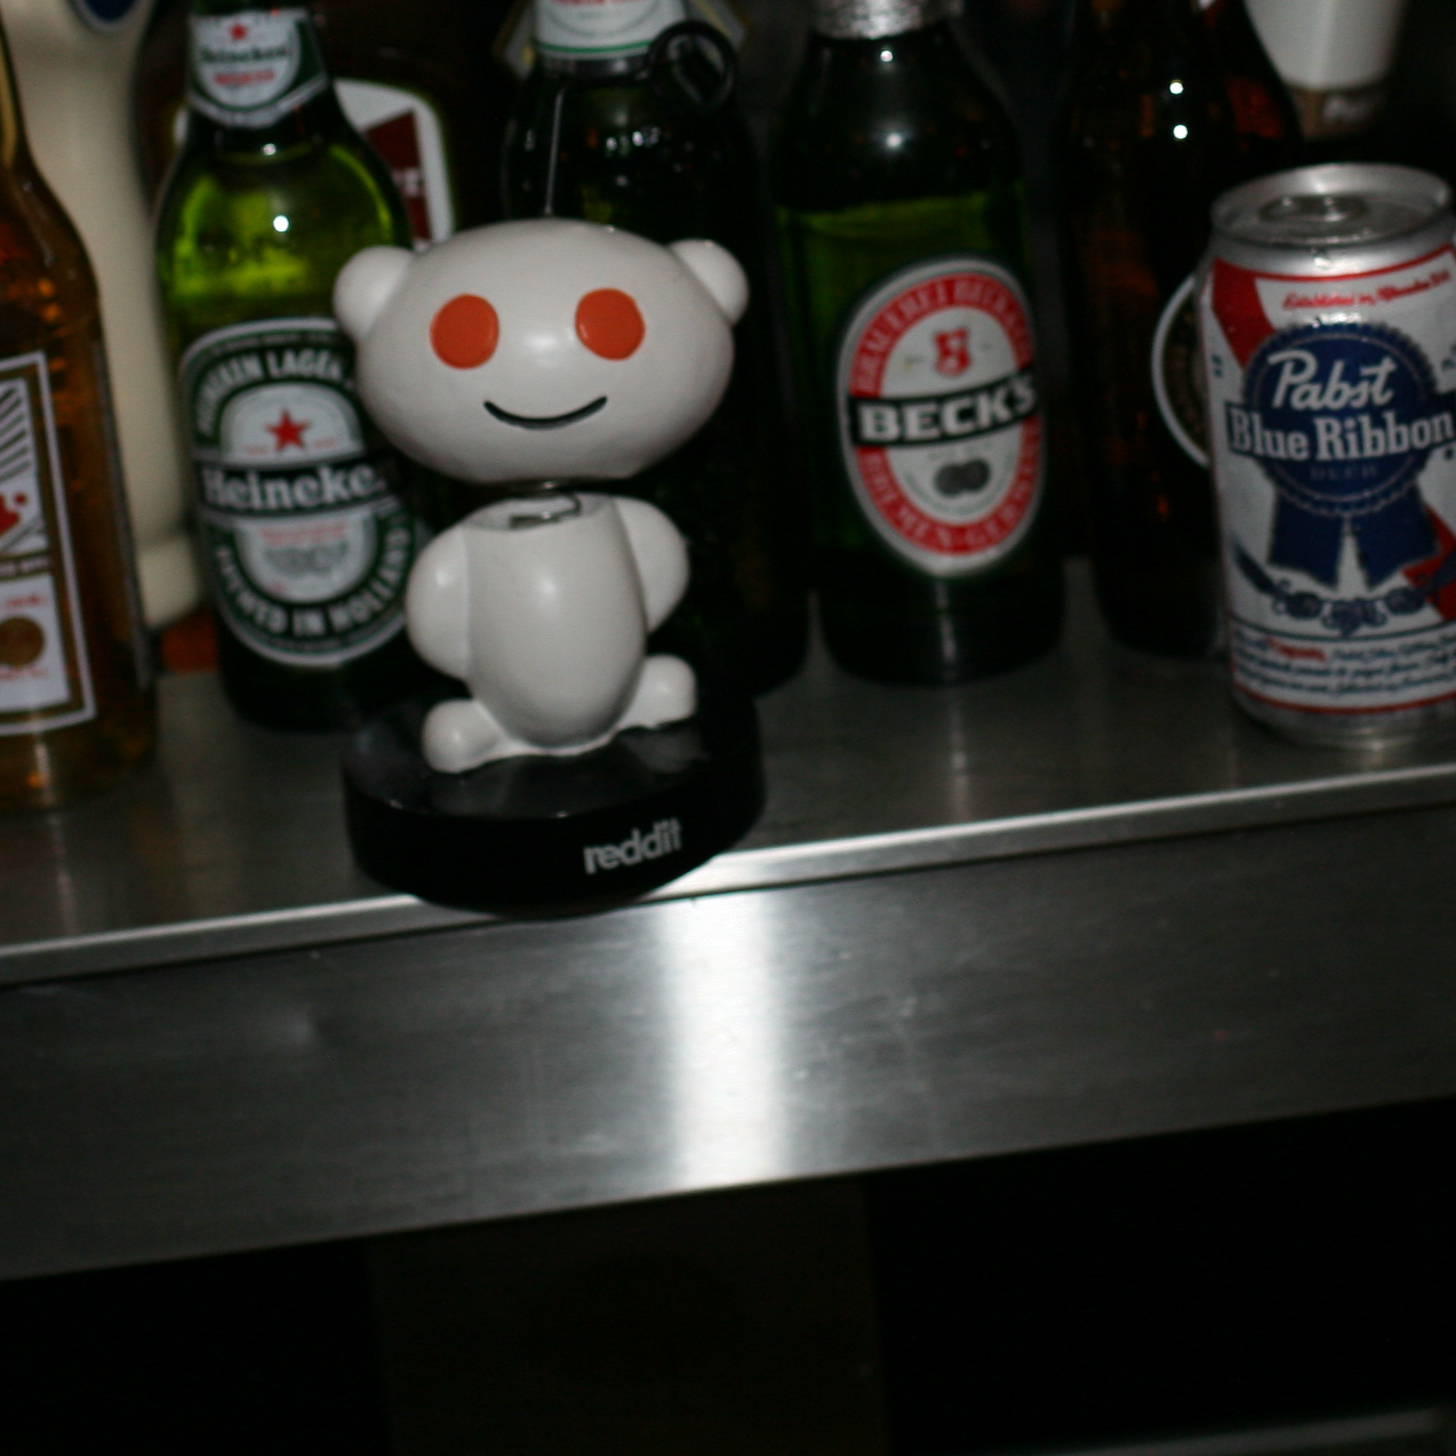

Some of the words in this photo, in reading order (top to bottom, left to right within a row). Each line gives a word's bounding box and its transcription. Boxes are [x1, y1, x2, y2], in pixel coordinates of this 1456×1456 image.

[1267, 349, 1397, 411] Pabst
[1230, 406, 1309, 460] Blue
[1313, 403, 1456, 460] Ribbon
[582, 816, 684, 876] reddit
